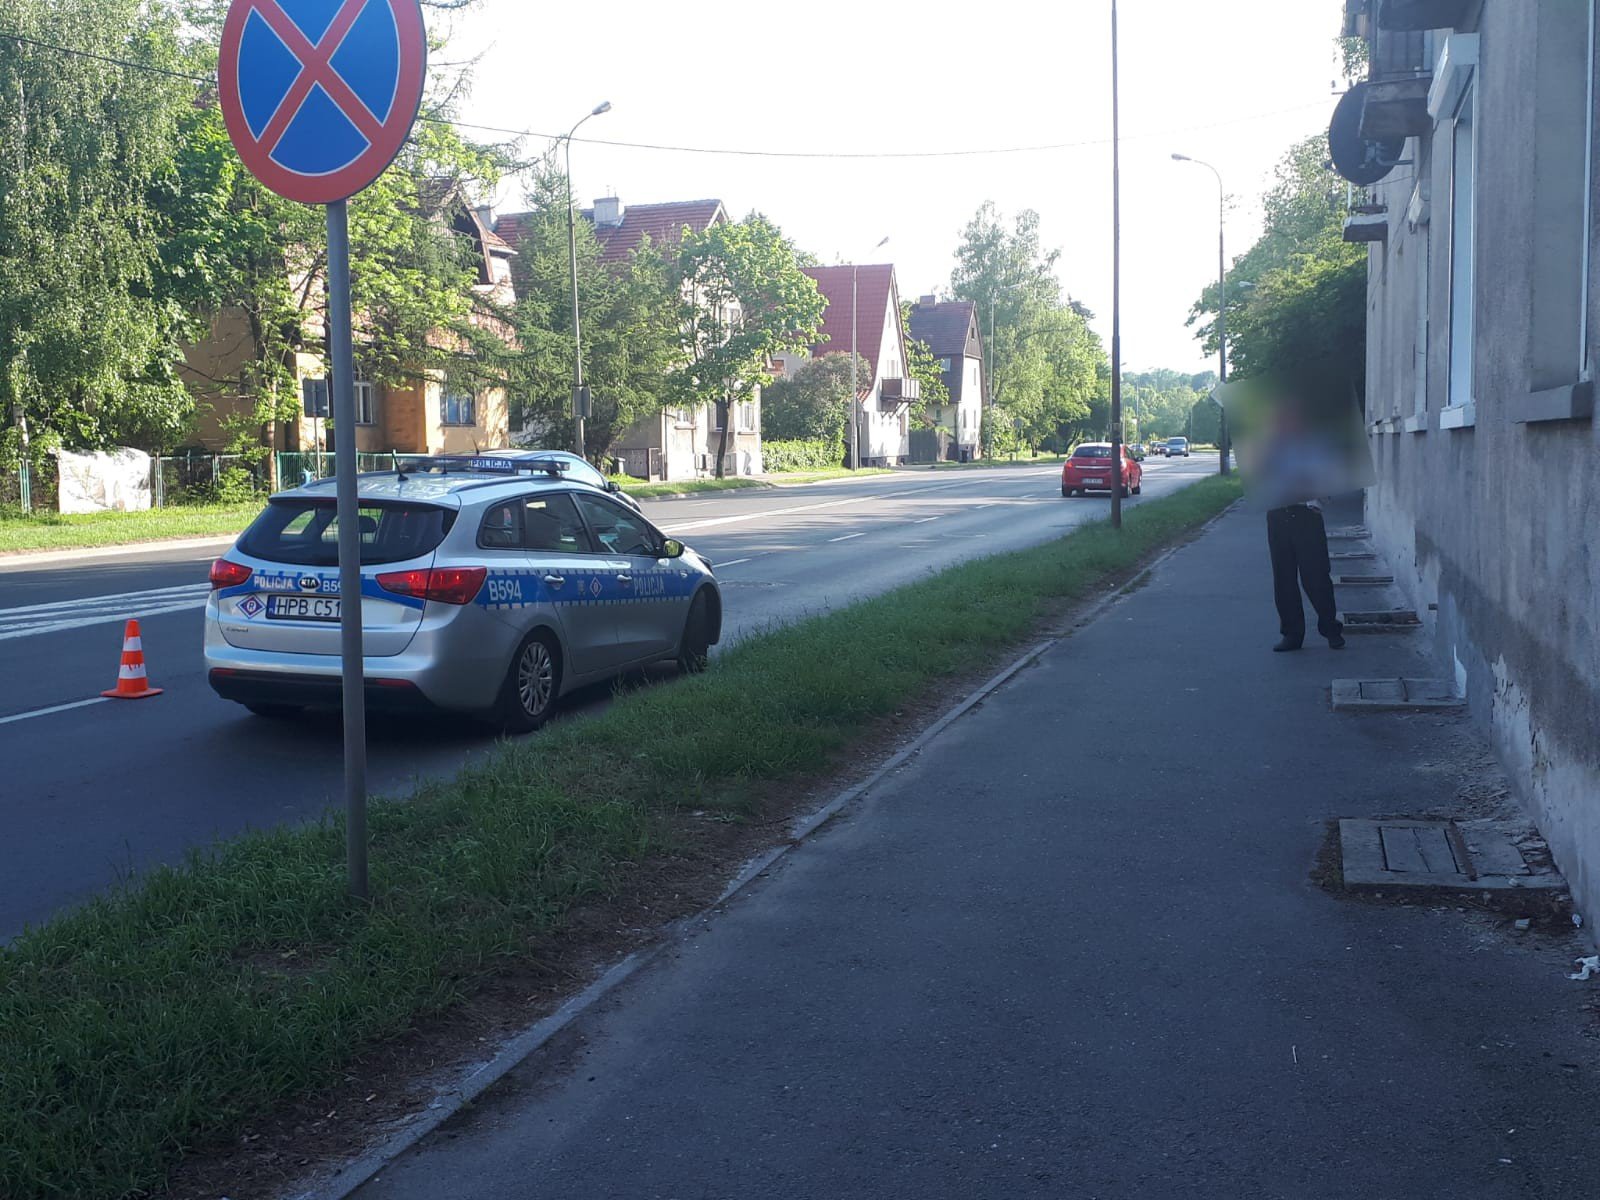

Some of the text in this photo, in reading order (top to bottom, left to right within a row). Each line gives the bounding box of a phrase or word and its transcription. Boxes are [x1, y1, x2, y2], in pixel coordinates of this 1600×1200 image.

[470, 459, 512, 469] POLICJA
[254, 575, 294, 589] POLICJA
[488, 579, 522, 601] B594
[634, 576, 665, 596] POLICJA
[277, 598, 309, 615] HPB
[314, 600, 341, 616] C51
